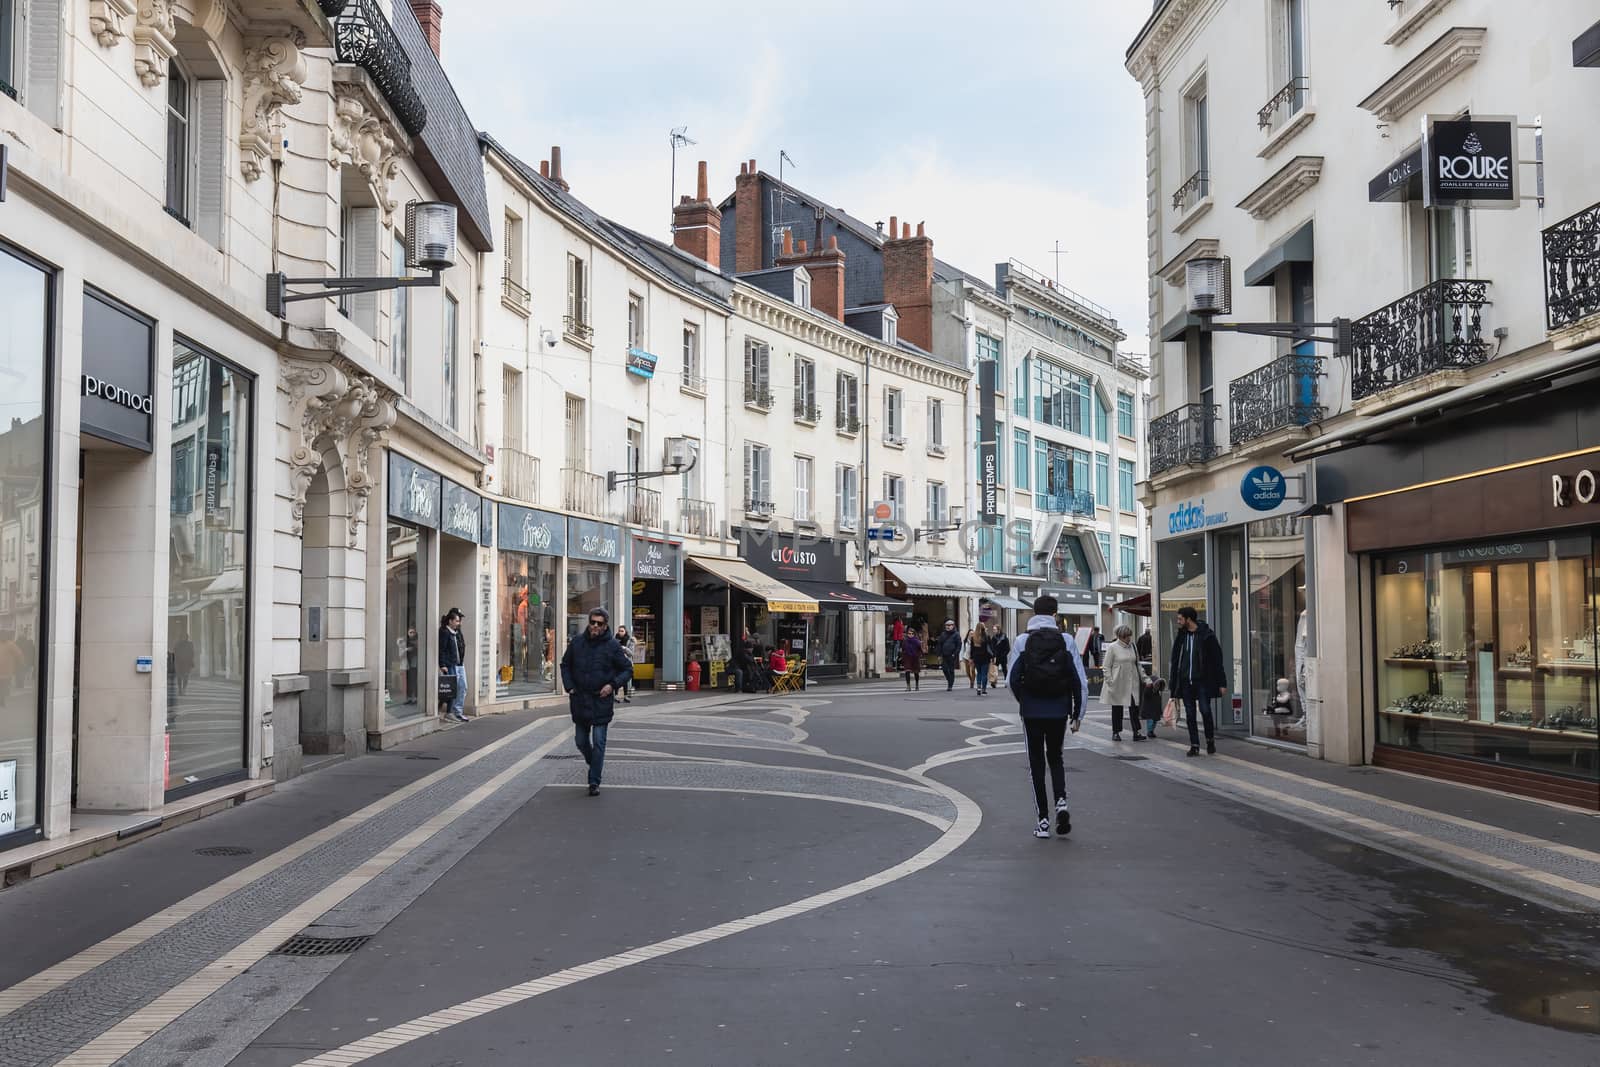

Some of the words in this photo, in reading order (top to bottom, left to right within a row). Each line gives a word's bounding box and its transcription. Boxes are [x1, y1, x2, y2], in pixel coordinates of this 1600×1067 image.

[1388, 161, 1412, 184] ROURE
[1440, 155, 1508, 179] ROURE
[86, 375, 152, 414] promod
[986, 454, 996, 515] PRINTEMPS
[1253, 491, 1280, 500] adidas
[1552, 469, 1596, 507] RO
[1168, 500, 1204, 534] adidas
[771, 546, 816, 565] CIGUSTO
